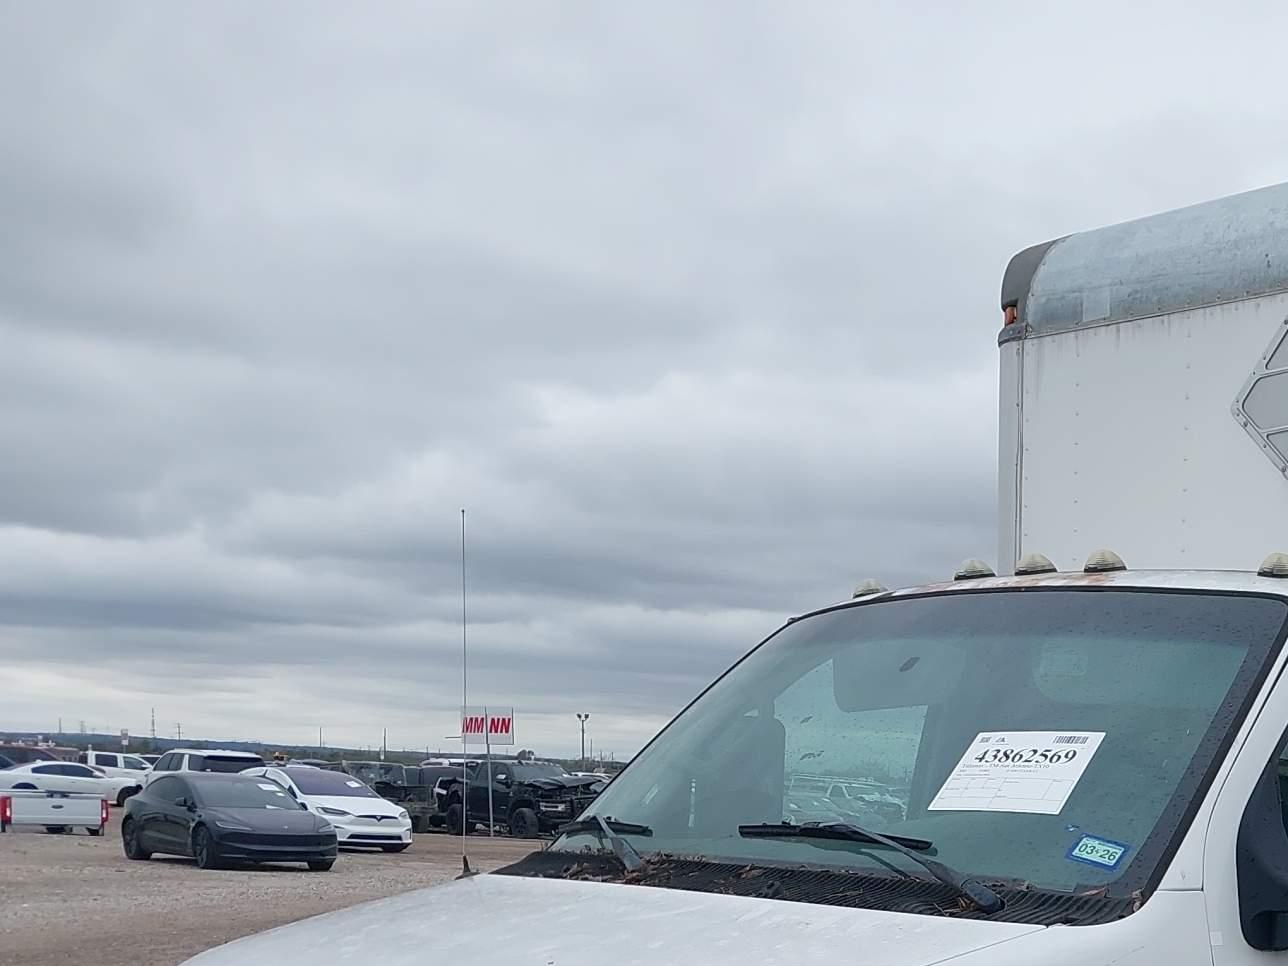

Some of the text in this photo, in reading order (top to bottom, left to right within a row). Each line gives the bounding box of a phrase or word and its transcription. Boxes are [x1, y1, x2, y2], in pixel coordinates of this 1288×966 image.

[974, 747, 1078, 765] 43862569
[1078, 843, 1096, 856] 03
[1098, 849, 1119, 862] 26
